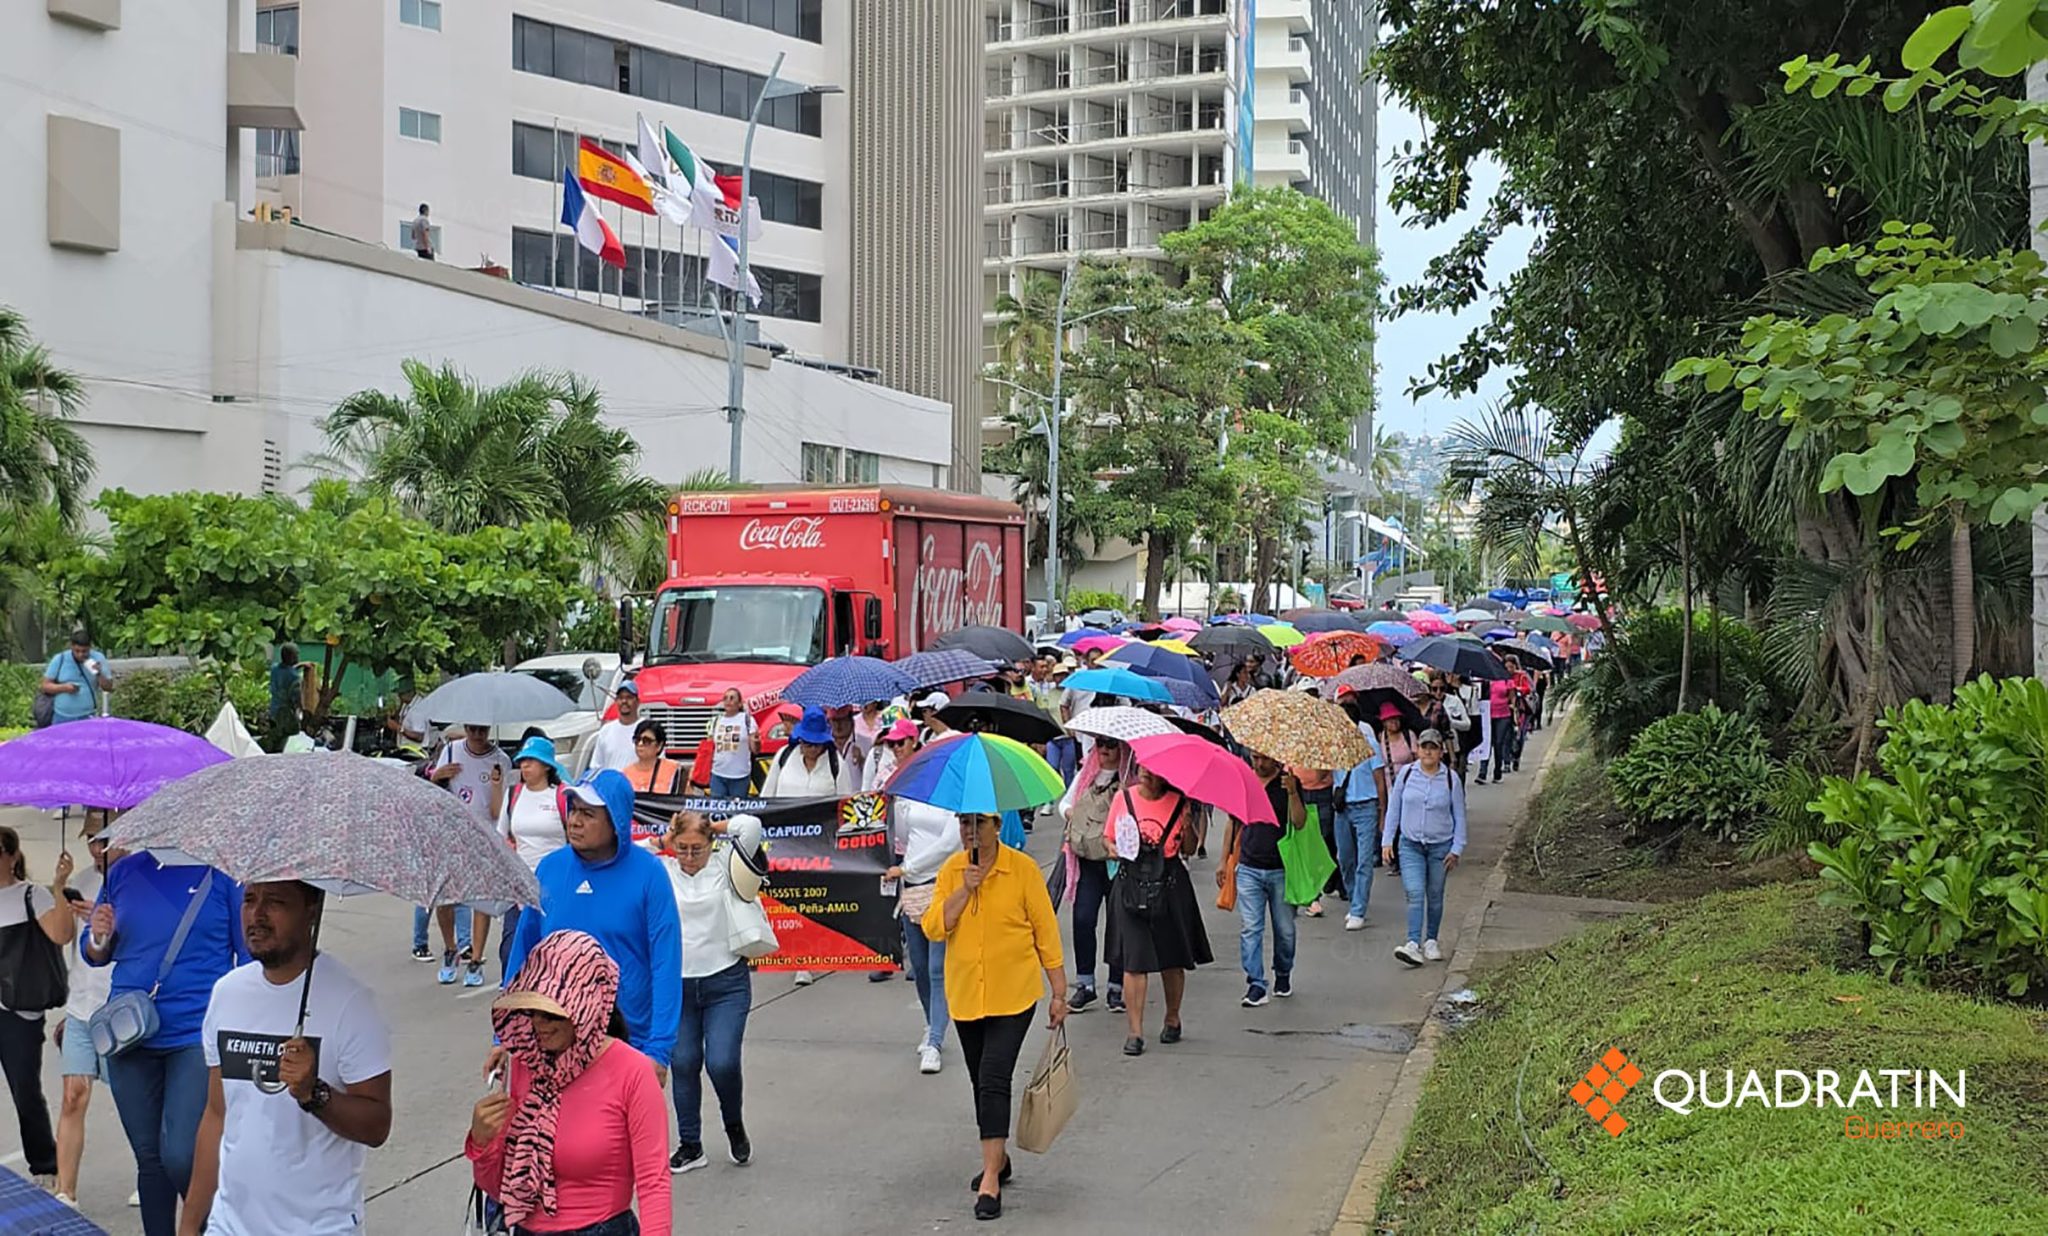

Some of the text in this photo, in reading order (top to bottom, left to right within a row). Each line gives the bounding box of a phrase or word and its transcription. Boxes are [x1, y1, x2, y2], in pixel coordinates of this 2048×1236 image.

[684, 500, 728, 512] RCK-071
[768, 856, 833, 872] IONAL
[803, 887, 828, 898] 2007
[777, 920, 803, 929] 100%
[226, 1038, 276, 1056] KENNETH
